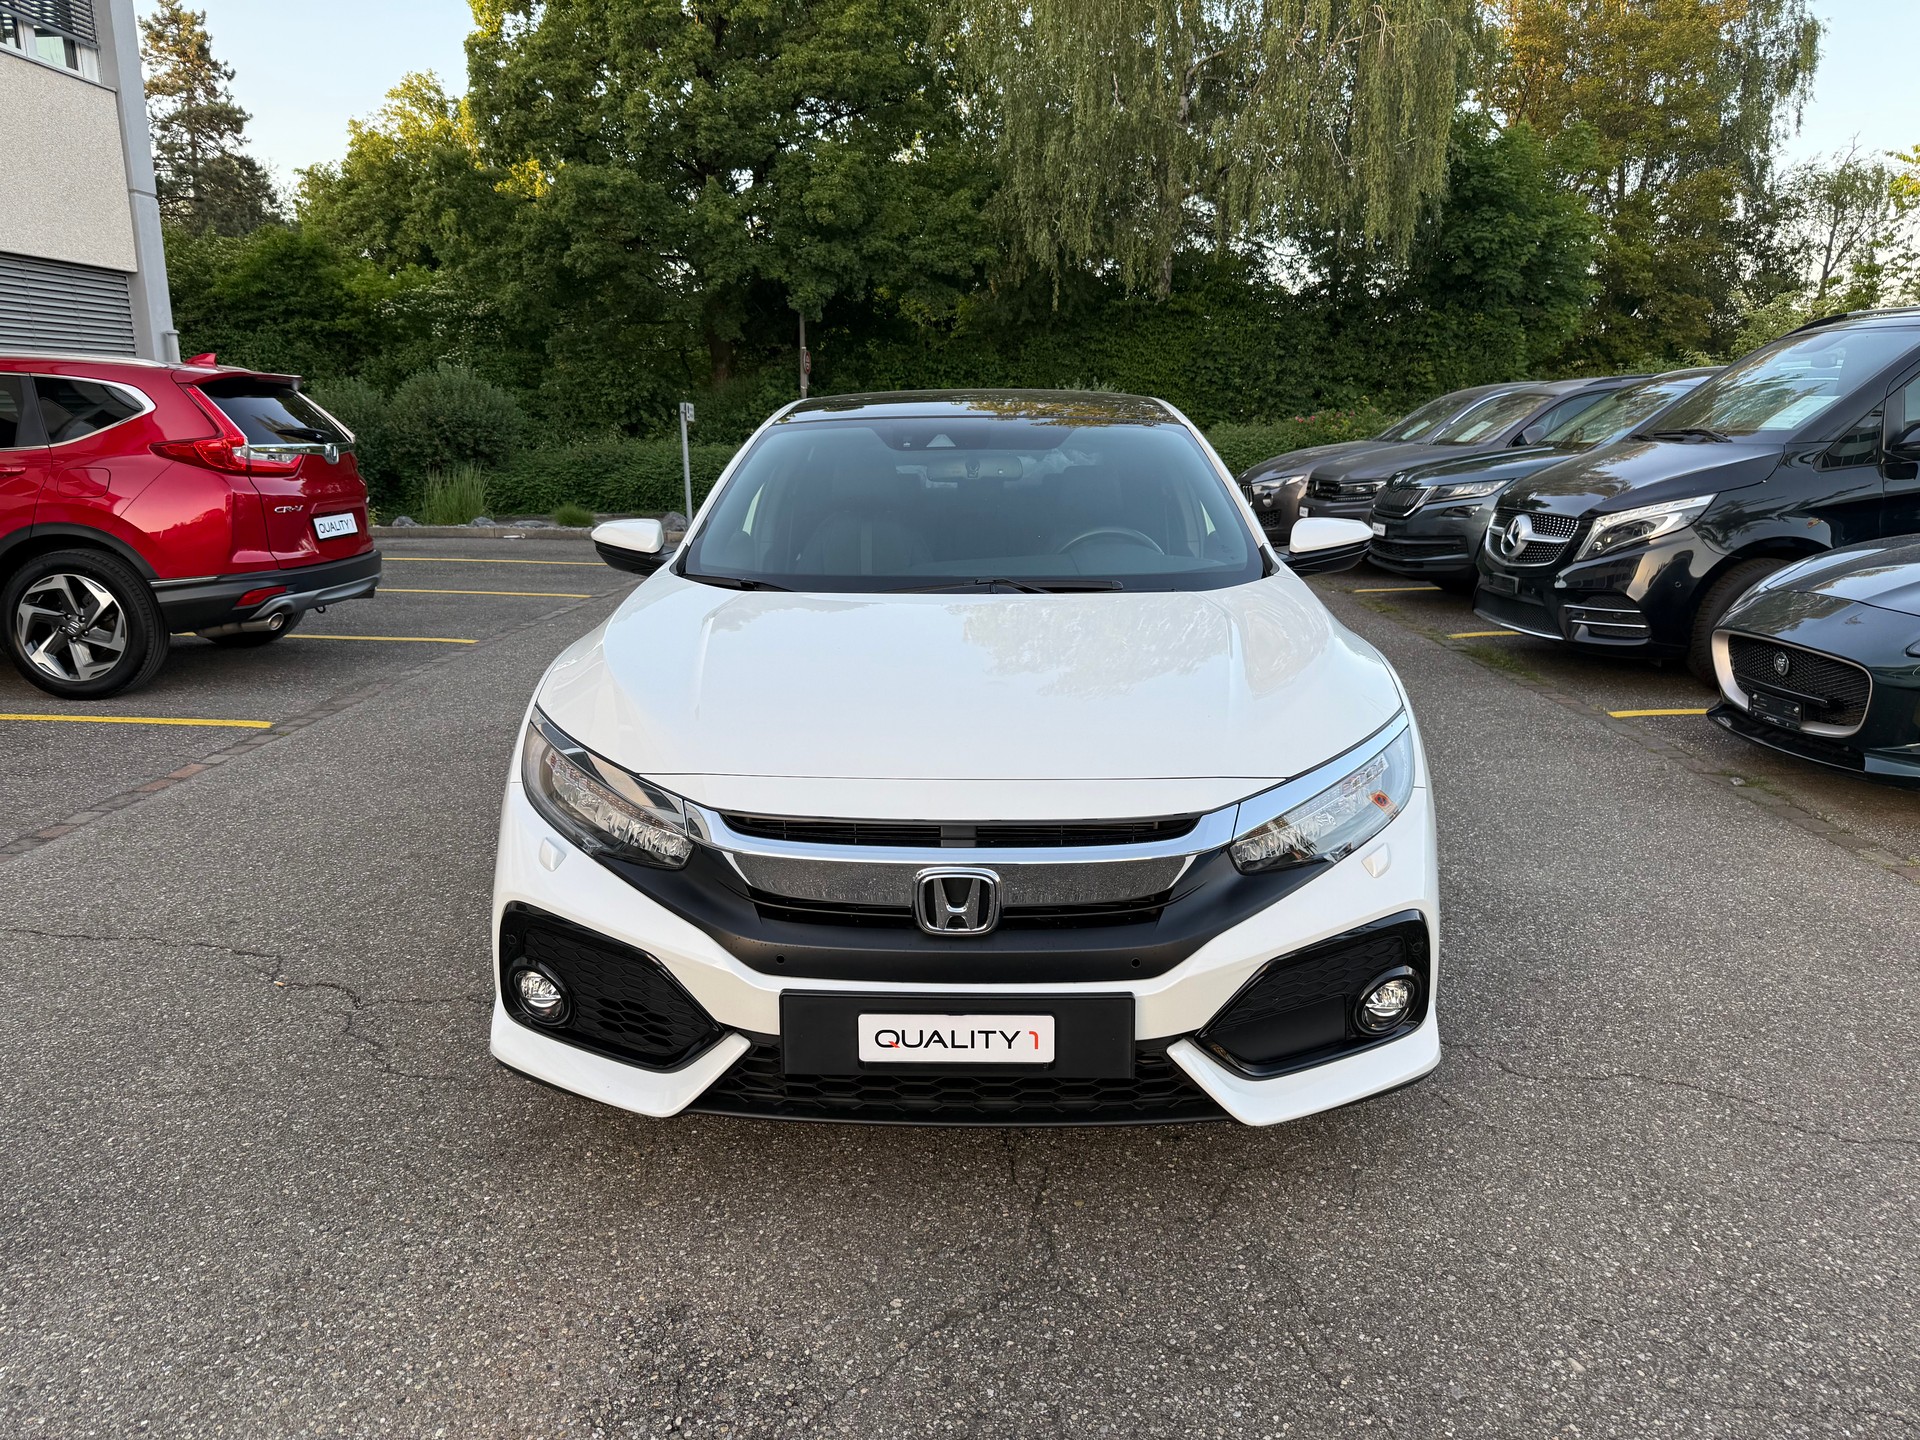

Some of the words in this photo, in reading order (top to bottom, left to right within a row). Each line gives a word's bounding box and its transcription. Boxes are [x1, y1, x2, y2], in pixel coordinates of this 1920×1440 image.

[274, 505, 304, 514] CR-V
[318, 520, 349, 534] QUALITY
[874, 1029, 1021, 1050] QUALITY
[1028, 1030, 1039, 1050] 1
